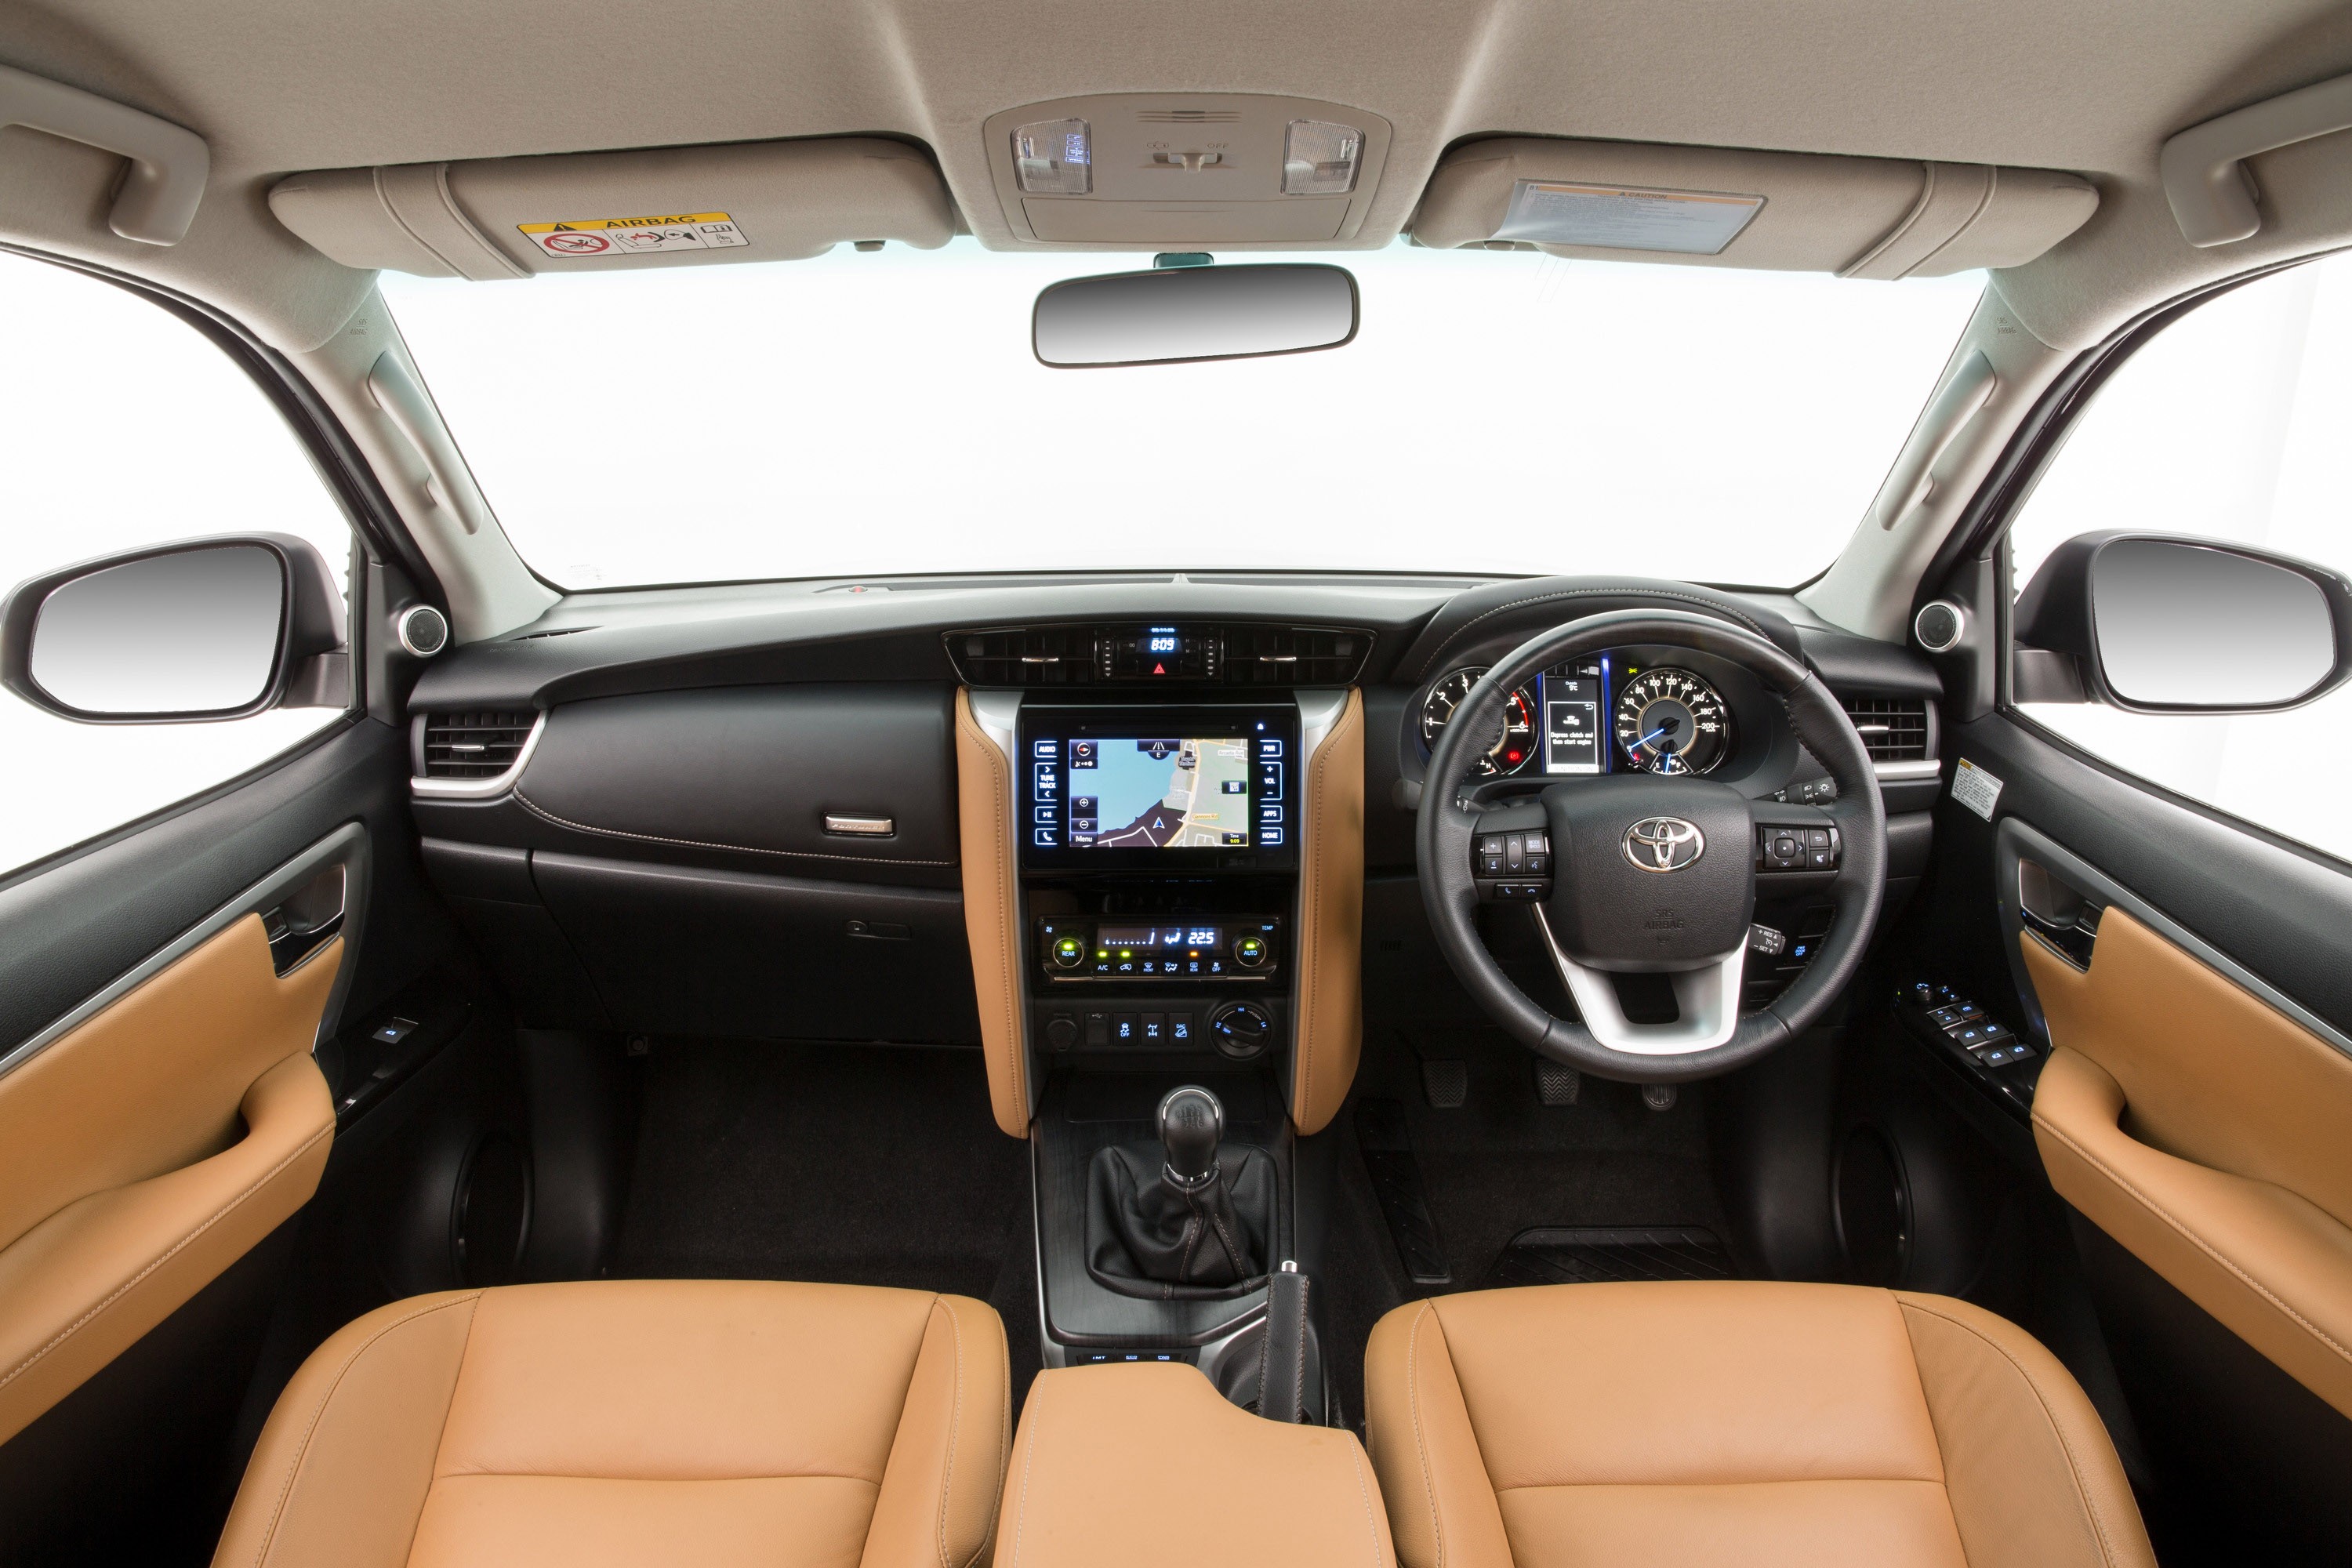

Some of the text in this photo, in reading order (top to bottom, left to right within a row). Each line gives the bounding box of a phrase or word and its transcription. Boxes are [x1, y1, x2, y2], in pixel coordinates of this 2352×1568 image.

[1628, 191, 1668, 200] CAUTION
[606, 216, 696, 228] AIRBAG
[1151, 638, 1174, 651] 8:09
[1462, 678, 1468, 688] 3
[1440, 691, 1446, 700] 2
[1510, 697, 1516, 706] 5
[1654, 909, 1674, 919] SRS
[1646, 920, 1684, 930] AIRBAG
[1188, 932, 1214, 945] 22.5
